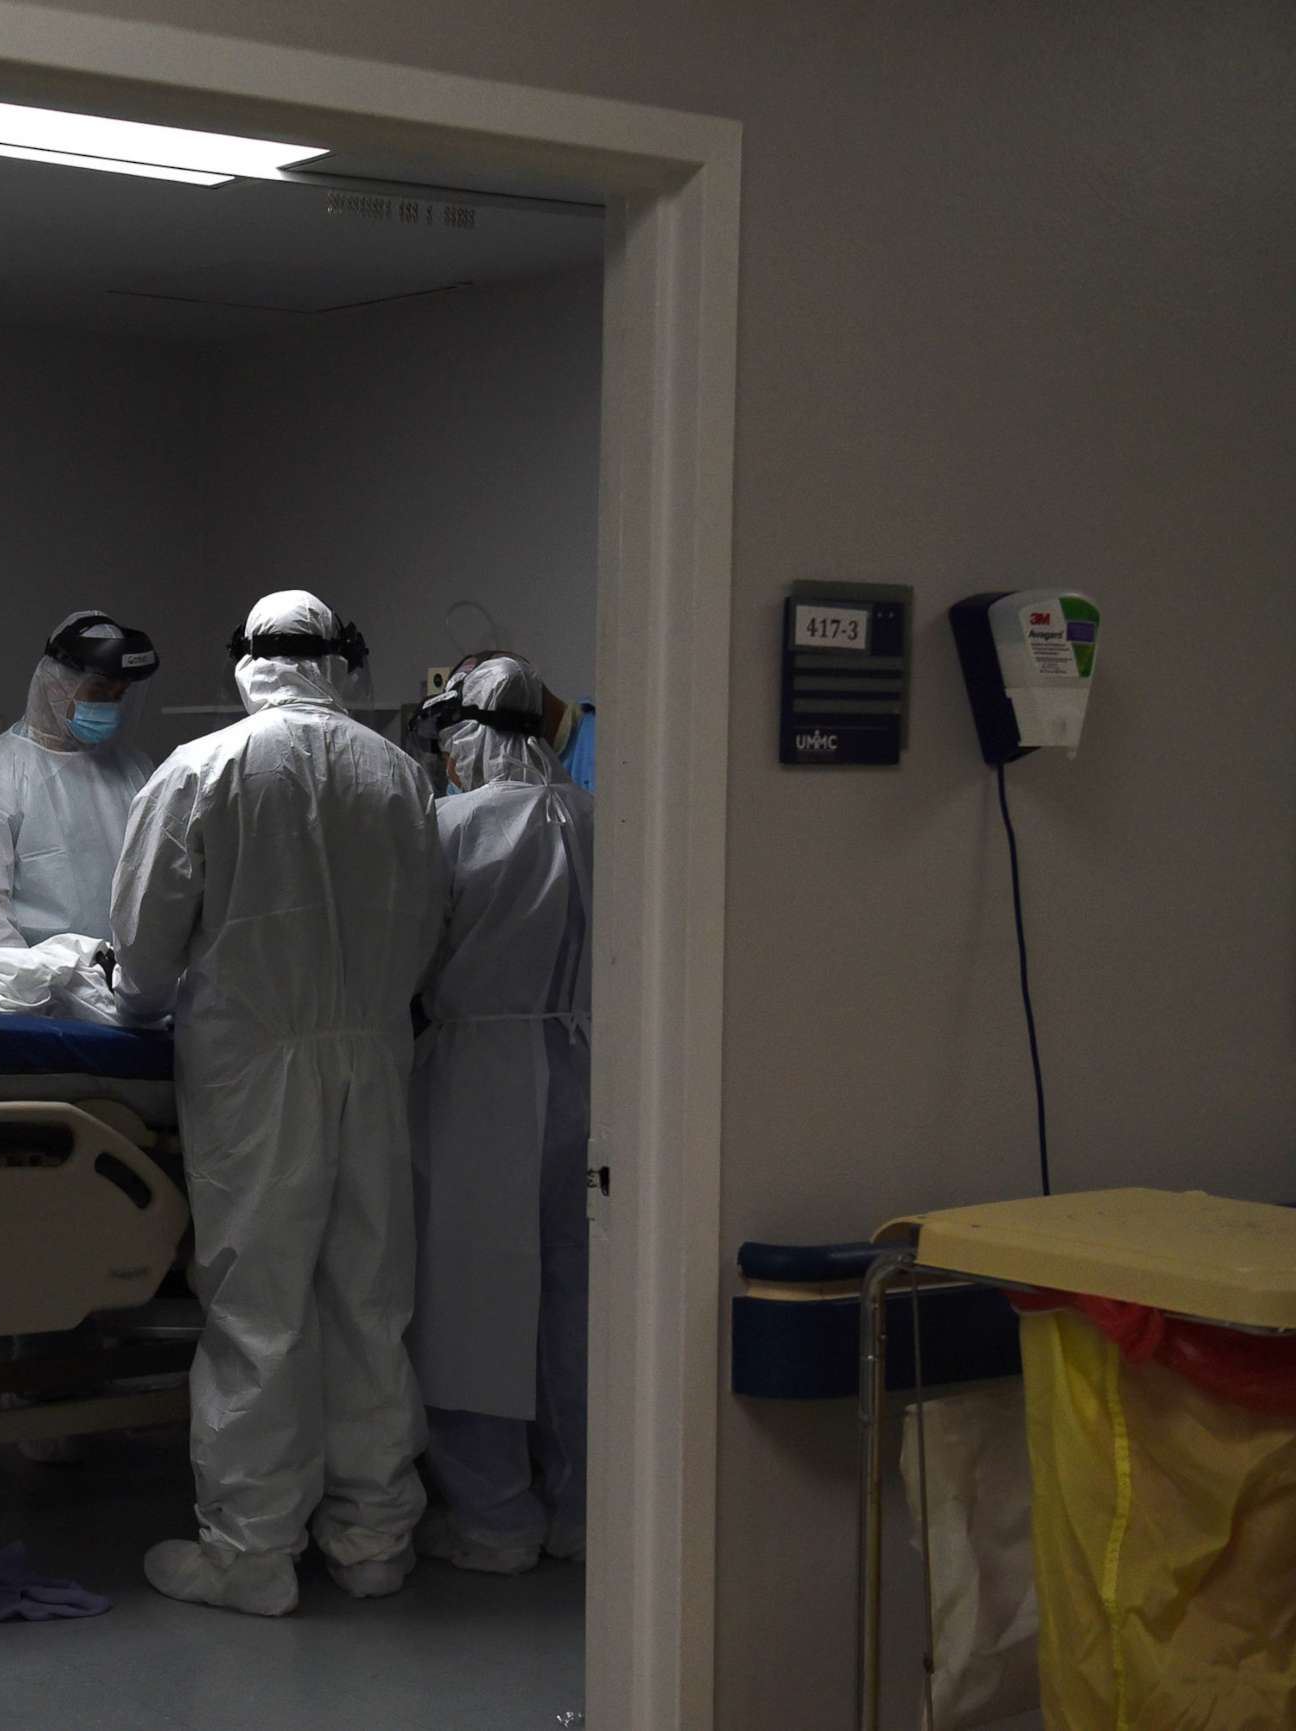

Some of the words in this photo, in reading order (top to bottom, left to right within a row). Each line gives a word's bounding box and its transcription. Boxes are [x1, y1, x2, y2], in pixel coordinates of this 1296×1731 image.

[1029, 612, 1051, 626] 3M
[806, 617, 859, 641] 417-3
[796, 733, 838, 750] UMMC
